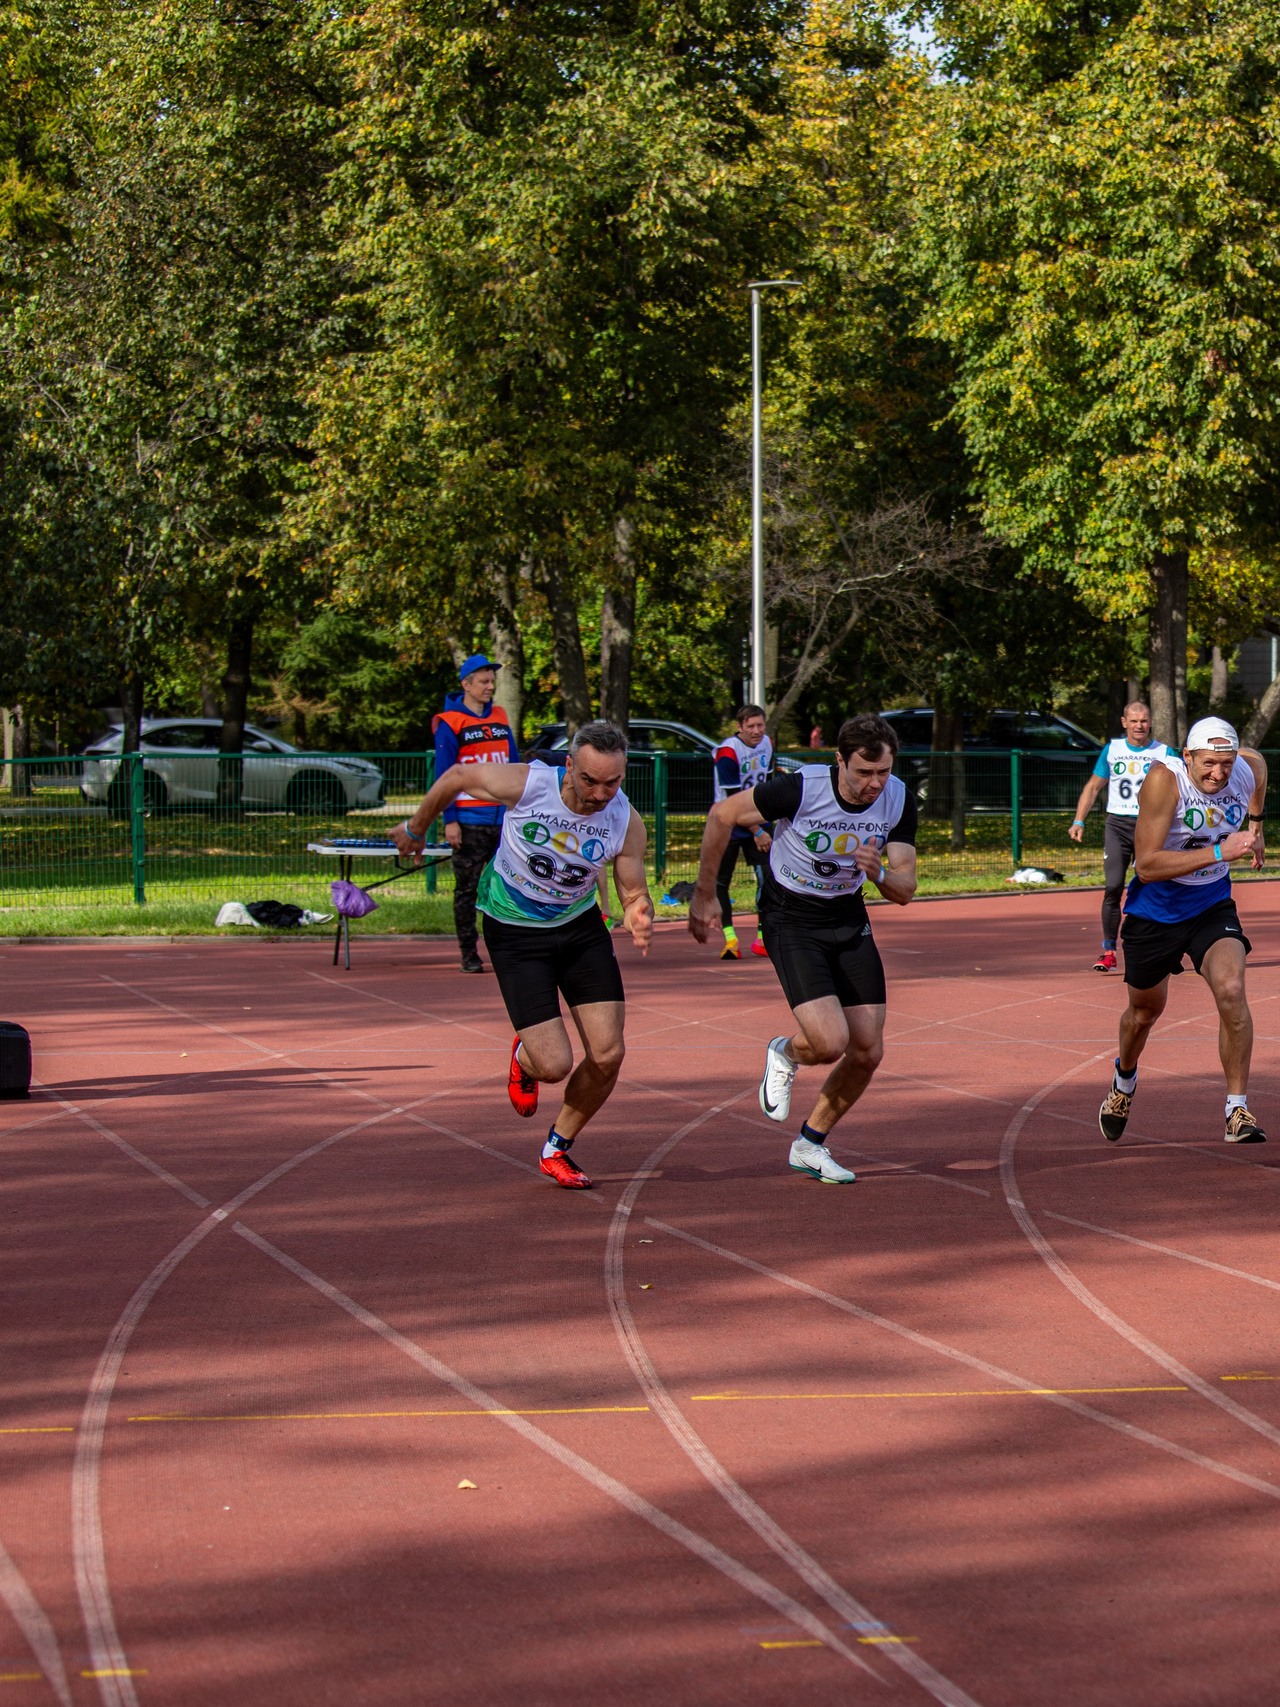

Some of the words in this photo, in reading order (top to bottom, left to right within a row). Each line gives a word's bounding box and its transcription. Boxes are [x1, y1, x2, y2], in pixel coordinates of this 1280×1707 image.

[465, 730, 483, 741] Arta
[1184, 793, 1241, 806] VMARAFONE
[531, 809, 610, 839] VMARAFONE
[809, 819, 889, 832] VMARAFONE
